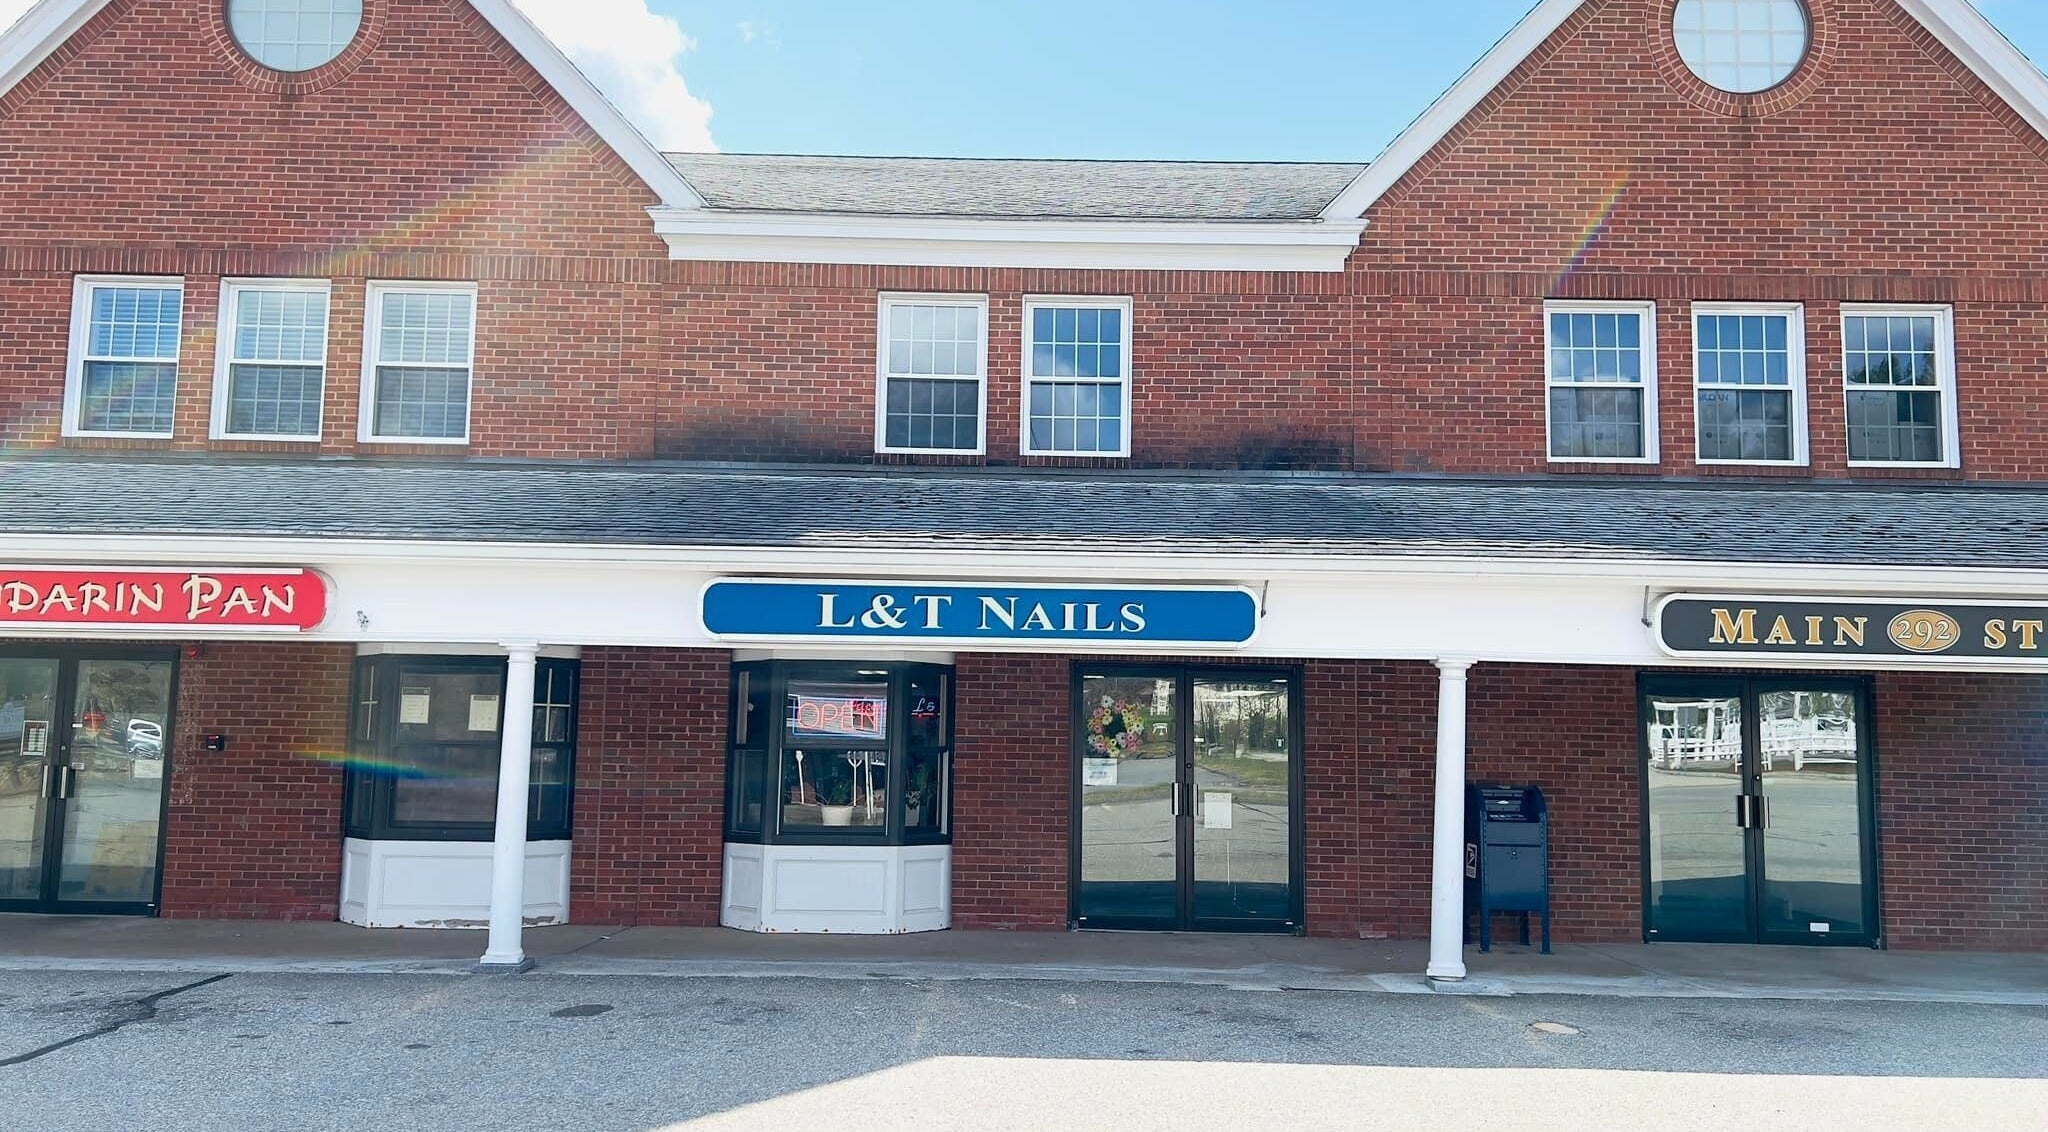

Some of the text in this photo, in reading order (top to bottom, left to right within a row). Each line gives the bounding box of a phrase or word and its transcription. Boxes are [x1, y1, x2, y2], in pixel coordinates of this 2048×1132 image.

[0, 573, 296, 621] DARIN PAN
[816, 592, 1147, 633] L&T NAILS
[1708, 608, 2044, 649] MAIN 292 ST
[797, 700, 880, 733] OPEN
